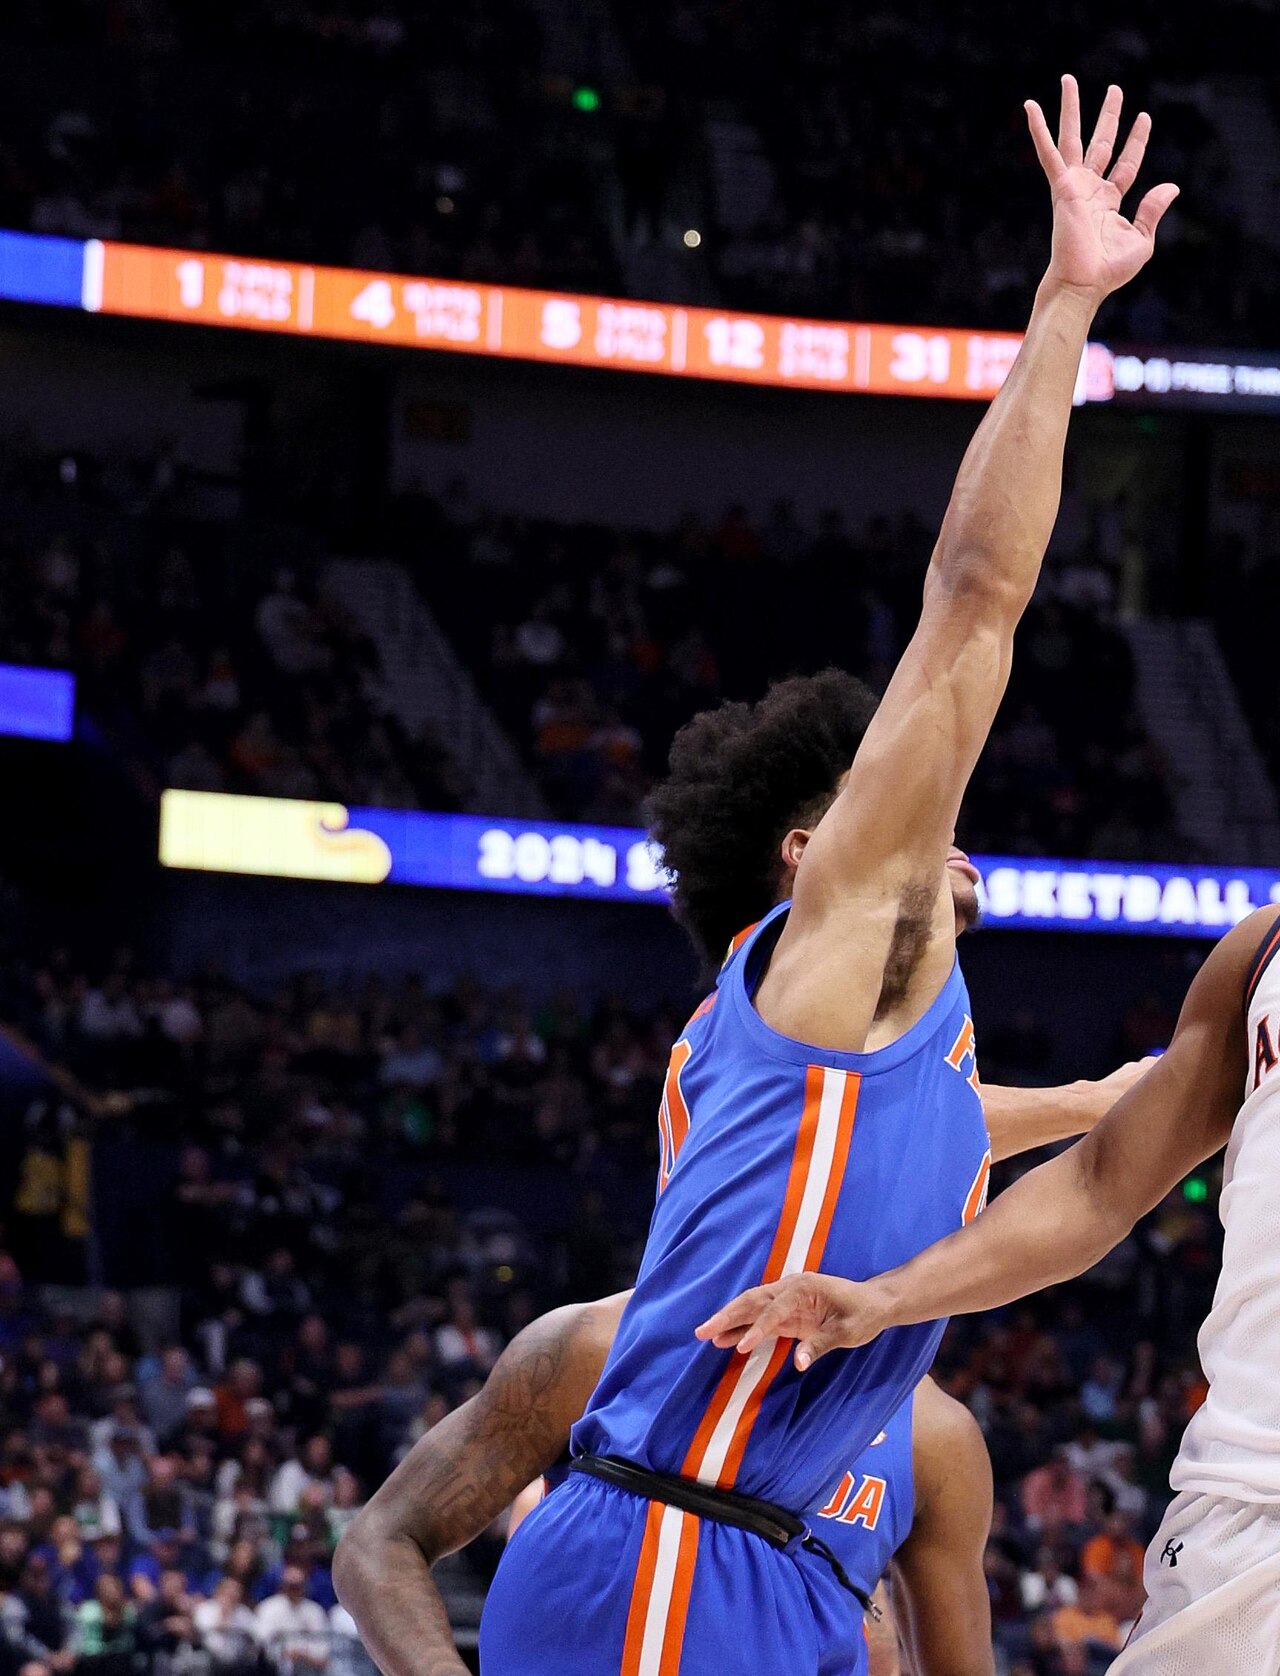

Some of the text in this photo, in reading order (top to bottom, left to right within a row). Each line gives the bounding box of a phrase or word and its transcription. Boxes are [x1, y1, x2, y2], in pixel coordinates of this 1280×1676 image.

[350, 279, 396, 330] 4
[704, 317, 766, 370] 12
[889, 332, 951, 385] 31
[477, 828, 617, 888] 2024
